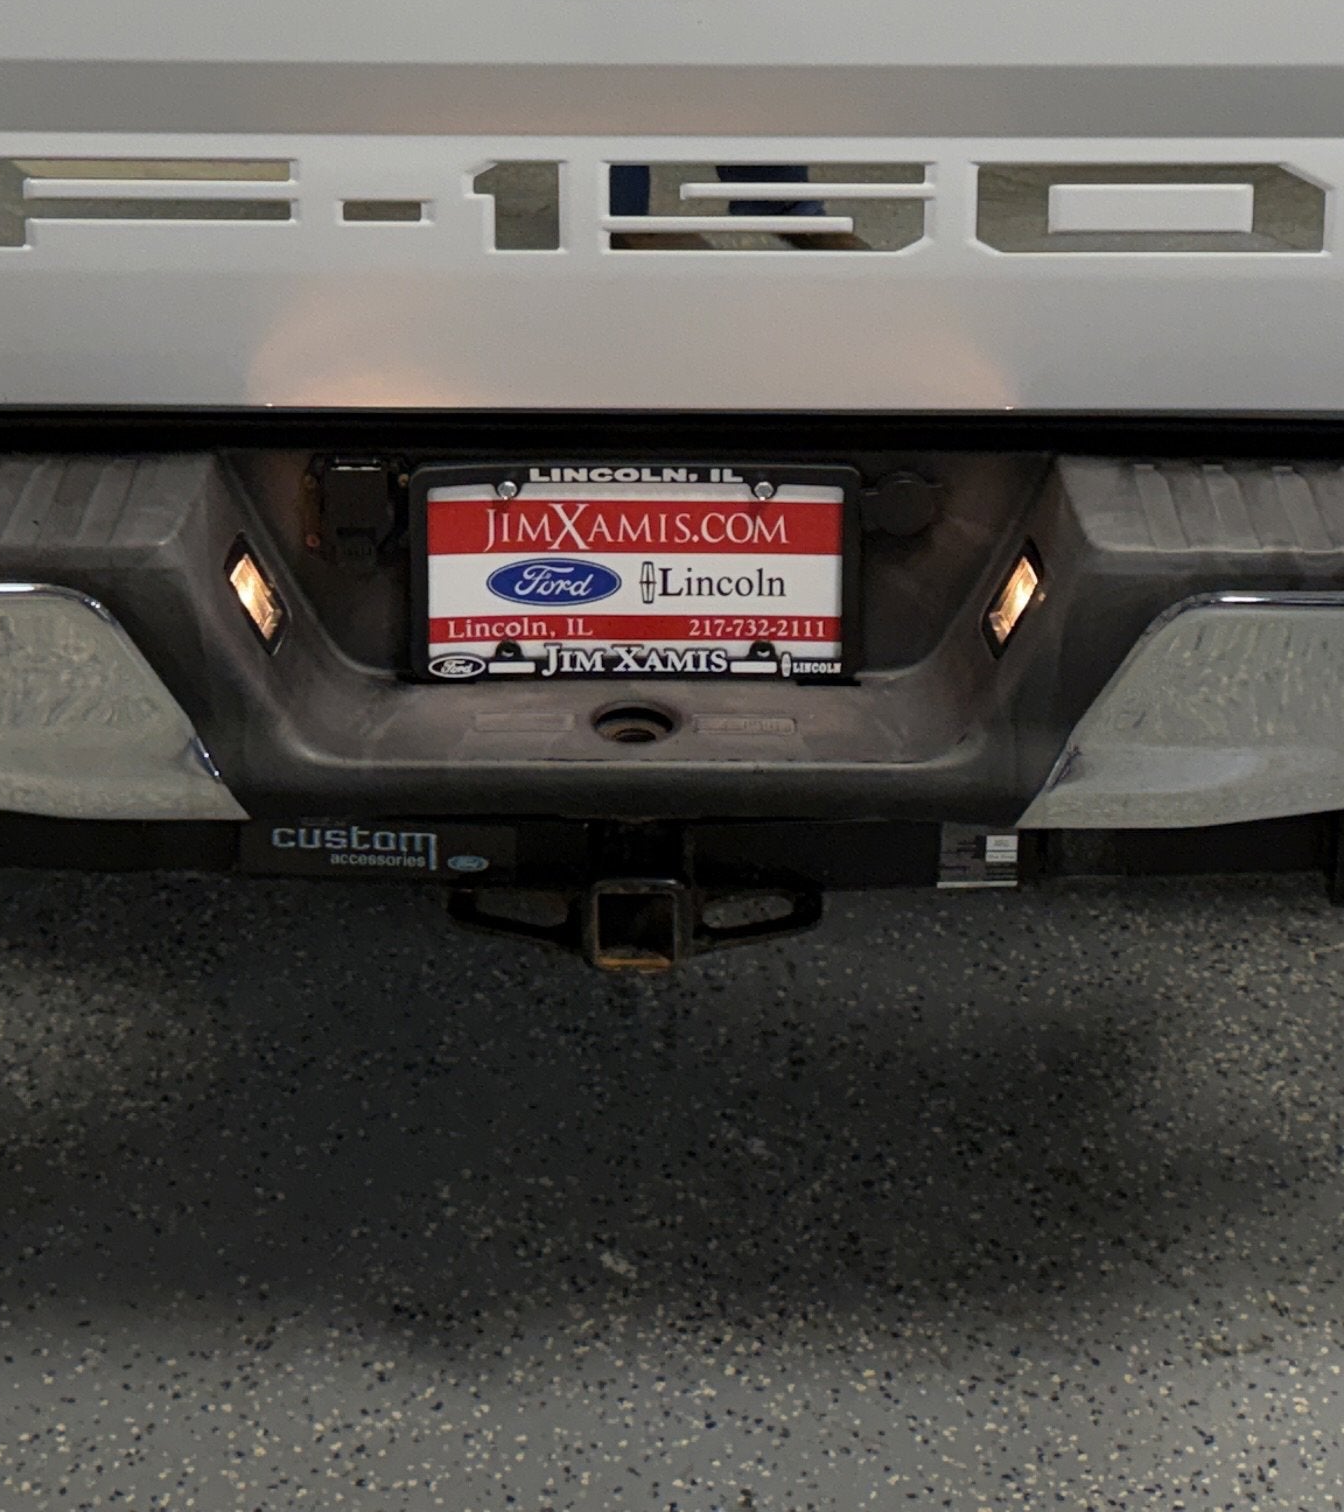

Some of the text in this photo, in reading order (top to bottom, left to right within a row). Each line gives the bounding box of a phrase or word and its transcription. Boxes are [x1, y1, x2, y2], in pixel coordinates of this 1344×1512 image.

[529, 467, 744, 484] LINCOLN, IL
[514, 564, 787, 598] Ford Lincoln
[447, 618, 594, 640] Lincoln, IL
[688, 619, 827, 638] 217-732-2111
[542, 644, 729, 677] JIM XAMIS
[792, 661, 842, 675] LINCOLN
[271, 825, 438, 871] custom
[330, 851, 426, 869] accessories
